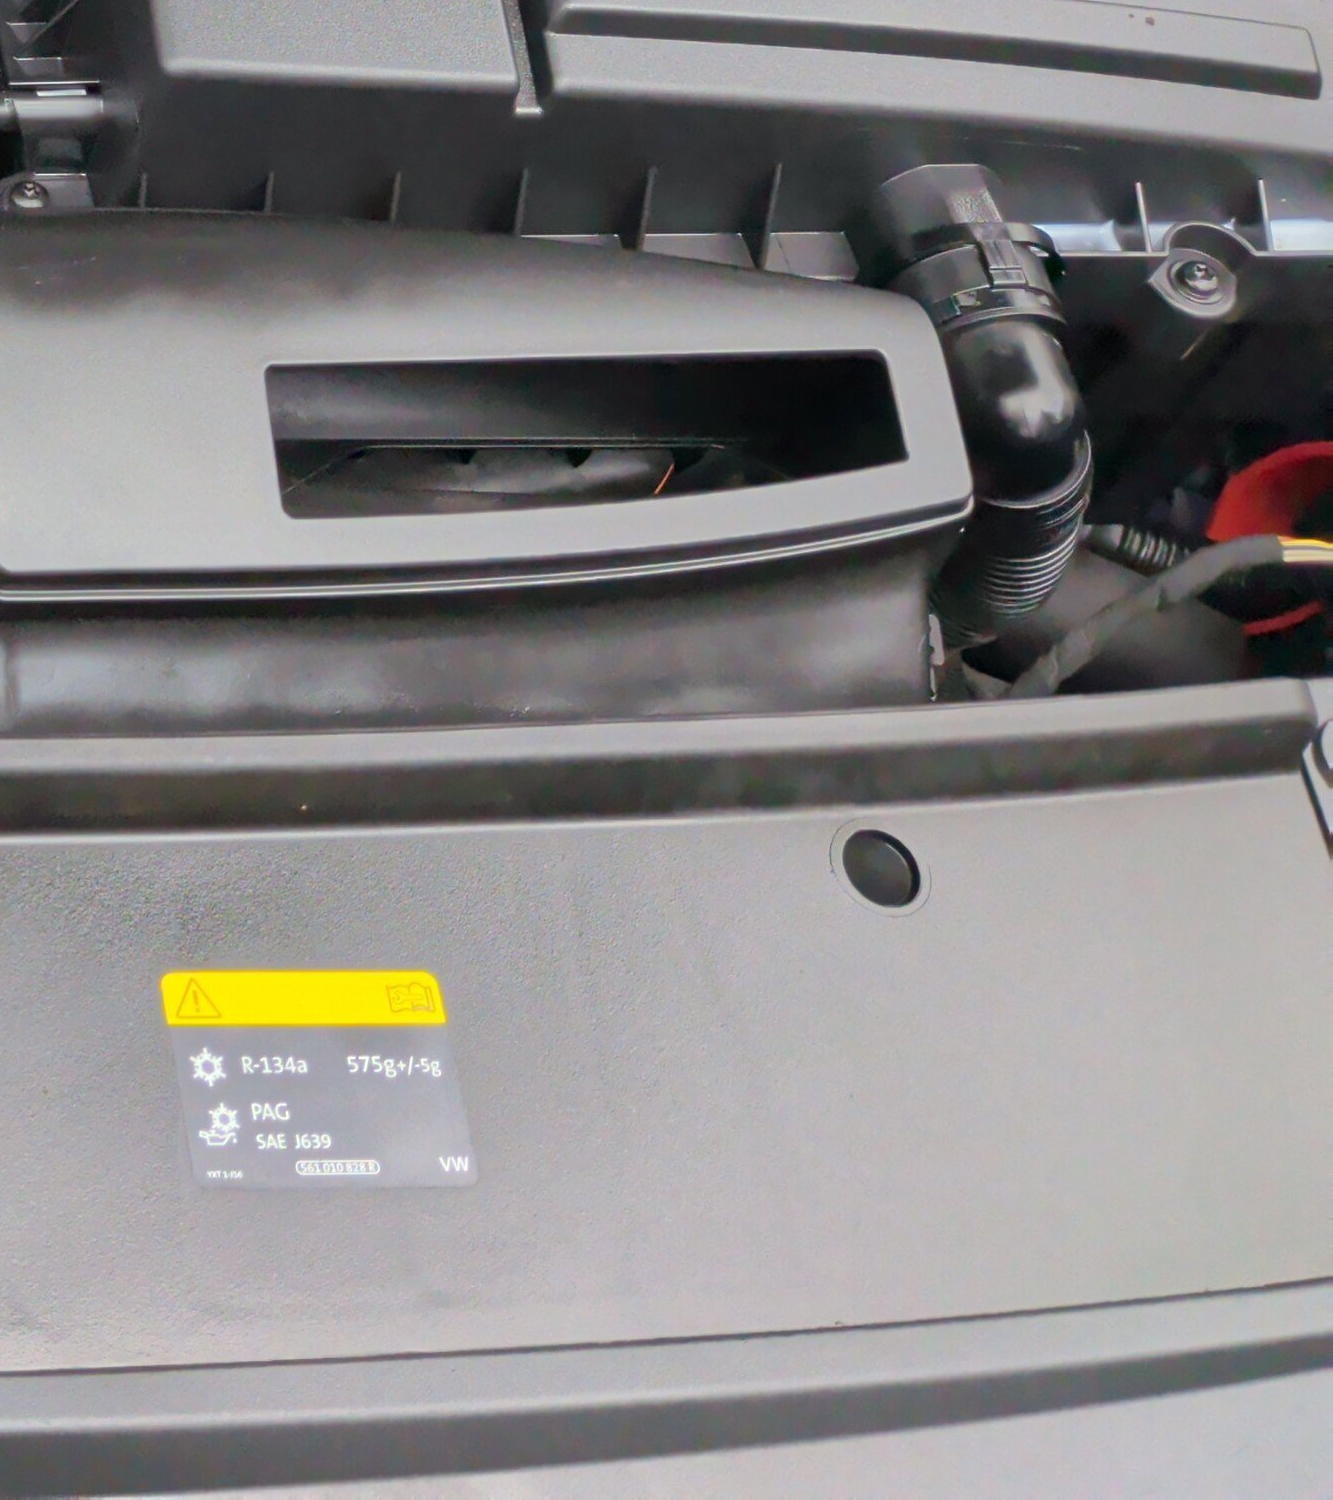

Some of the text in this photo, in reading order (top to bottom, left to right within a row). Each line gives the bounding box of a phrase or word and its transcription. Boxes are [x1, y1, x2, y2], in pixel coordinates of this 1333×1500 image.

[241, 1055, 442, 1078] R-134a 575g+/-5g
[251, 1102, 290, 1121] PAG
[256, 1133, 332, 1150] SAE J639
[439, 1156, 469, 1172] VW
